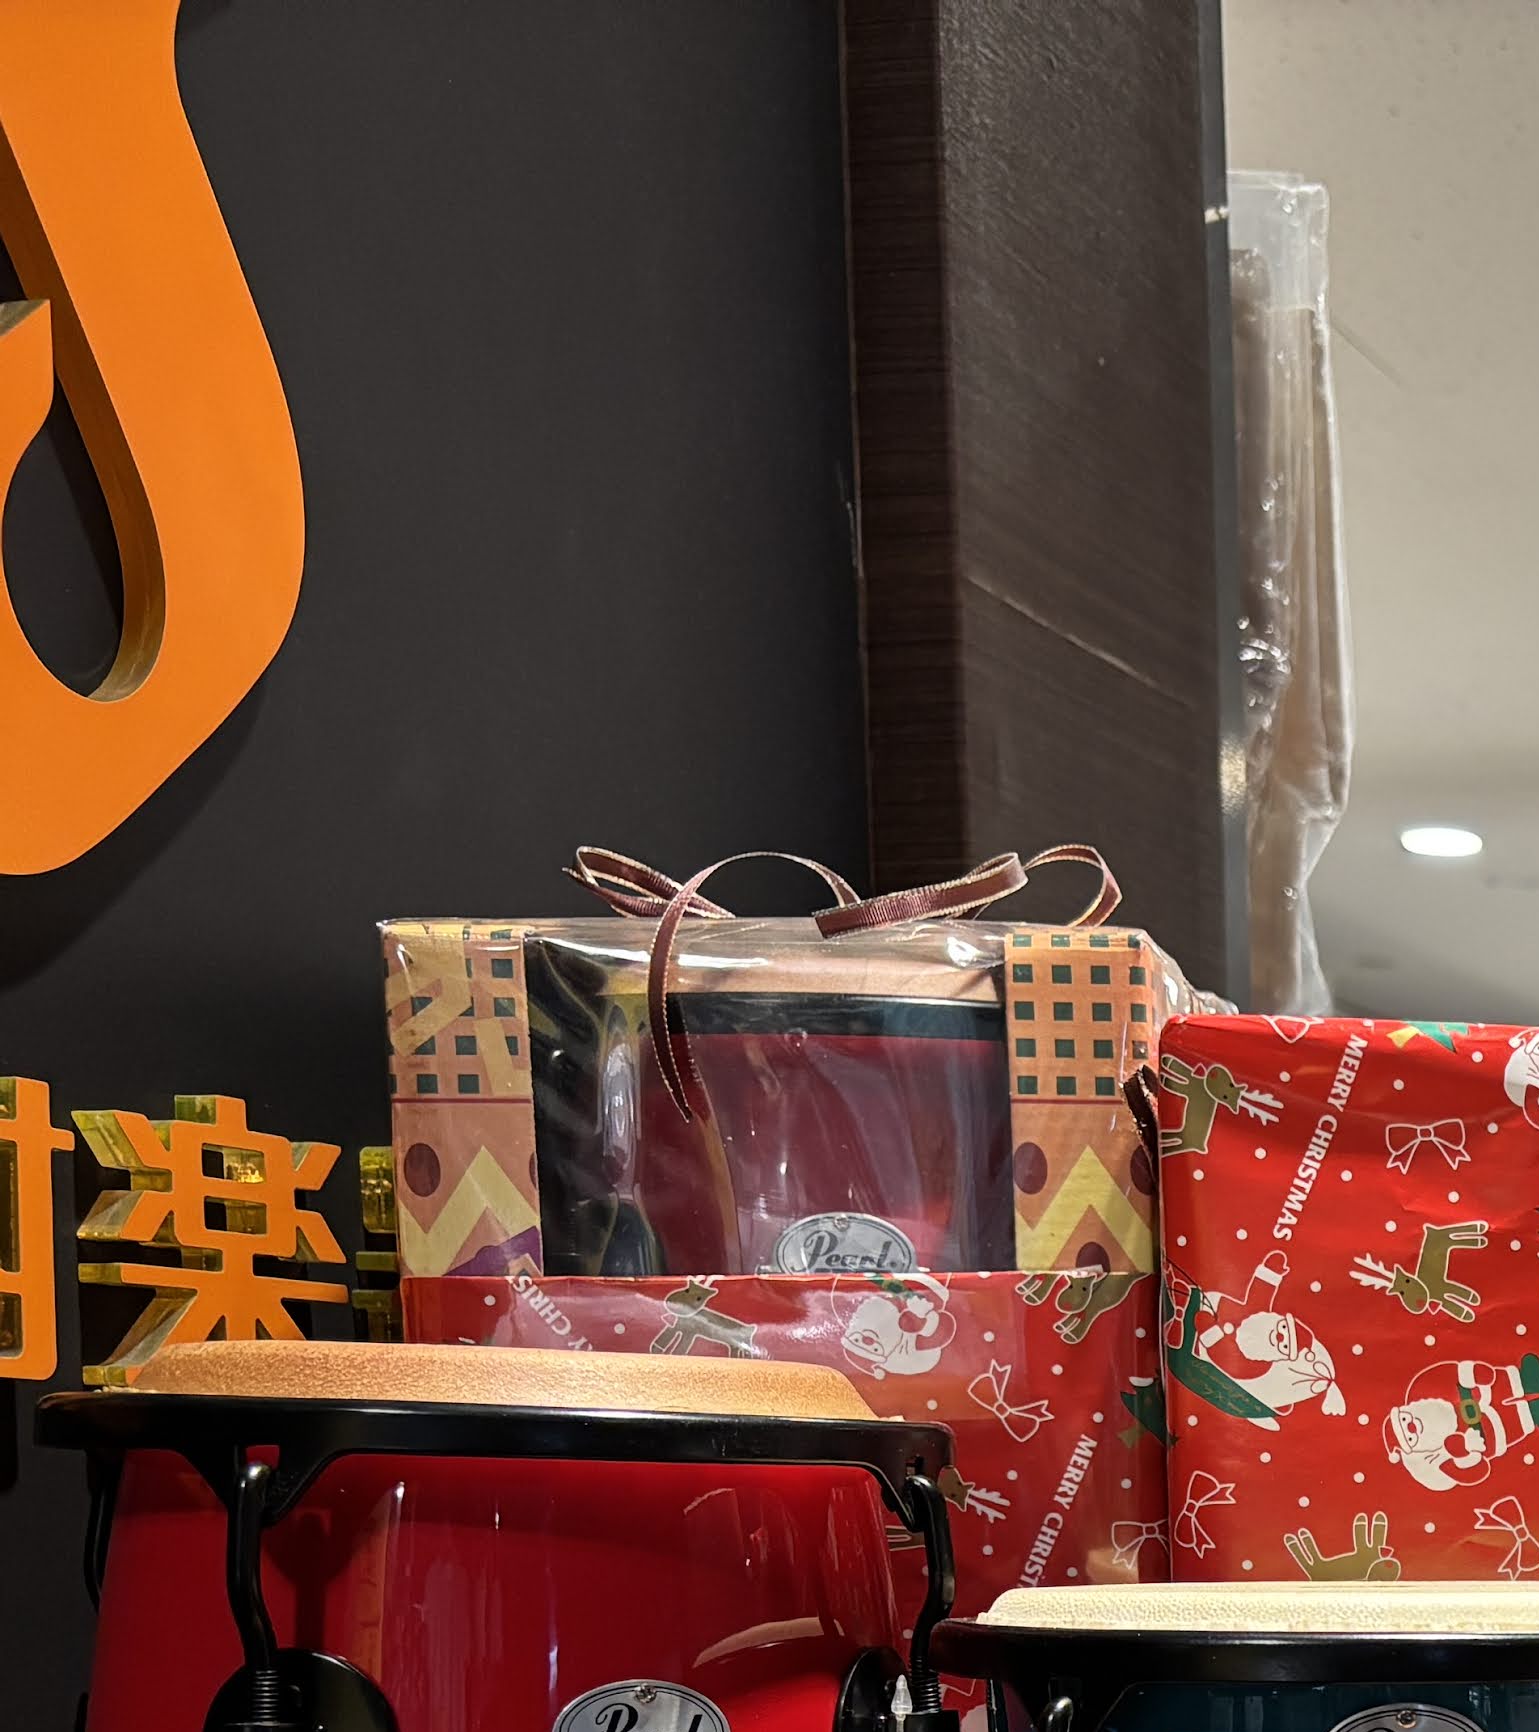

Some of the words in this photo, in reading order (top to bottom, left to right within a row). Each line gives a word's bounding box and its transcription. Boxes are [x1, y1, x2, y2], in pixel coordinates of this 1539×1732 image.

[1322, 1033, 1367, 1112] MERRY
[1272, 1111, 1339, 1243] CHRISTMAS
[799, 1224, 897, 1272] Pearl
[1060, 1434, 1098, 1508] MERRY
